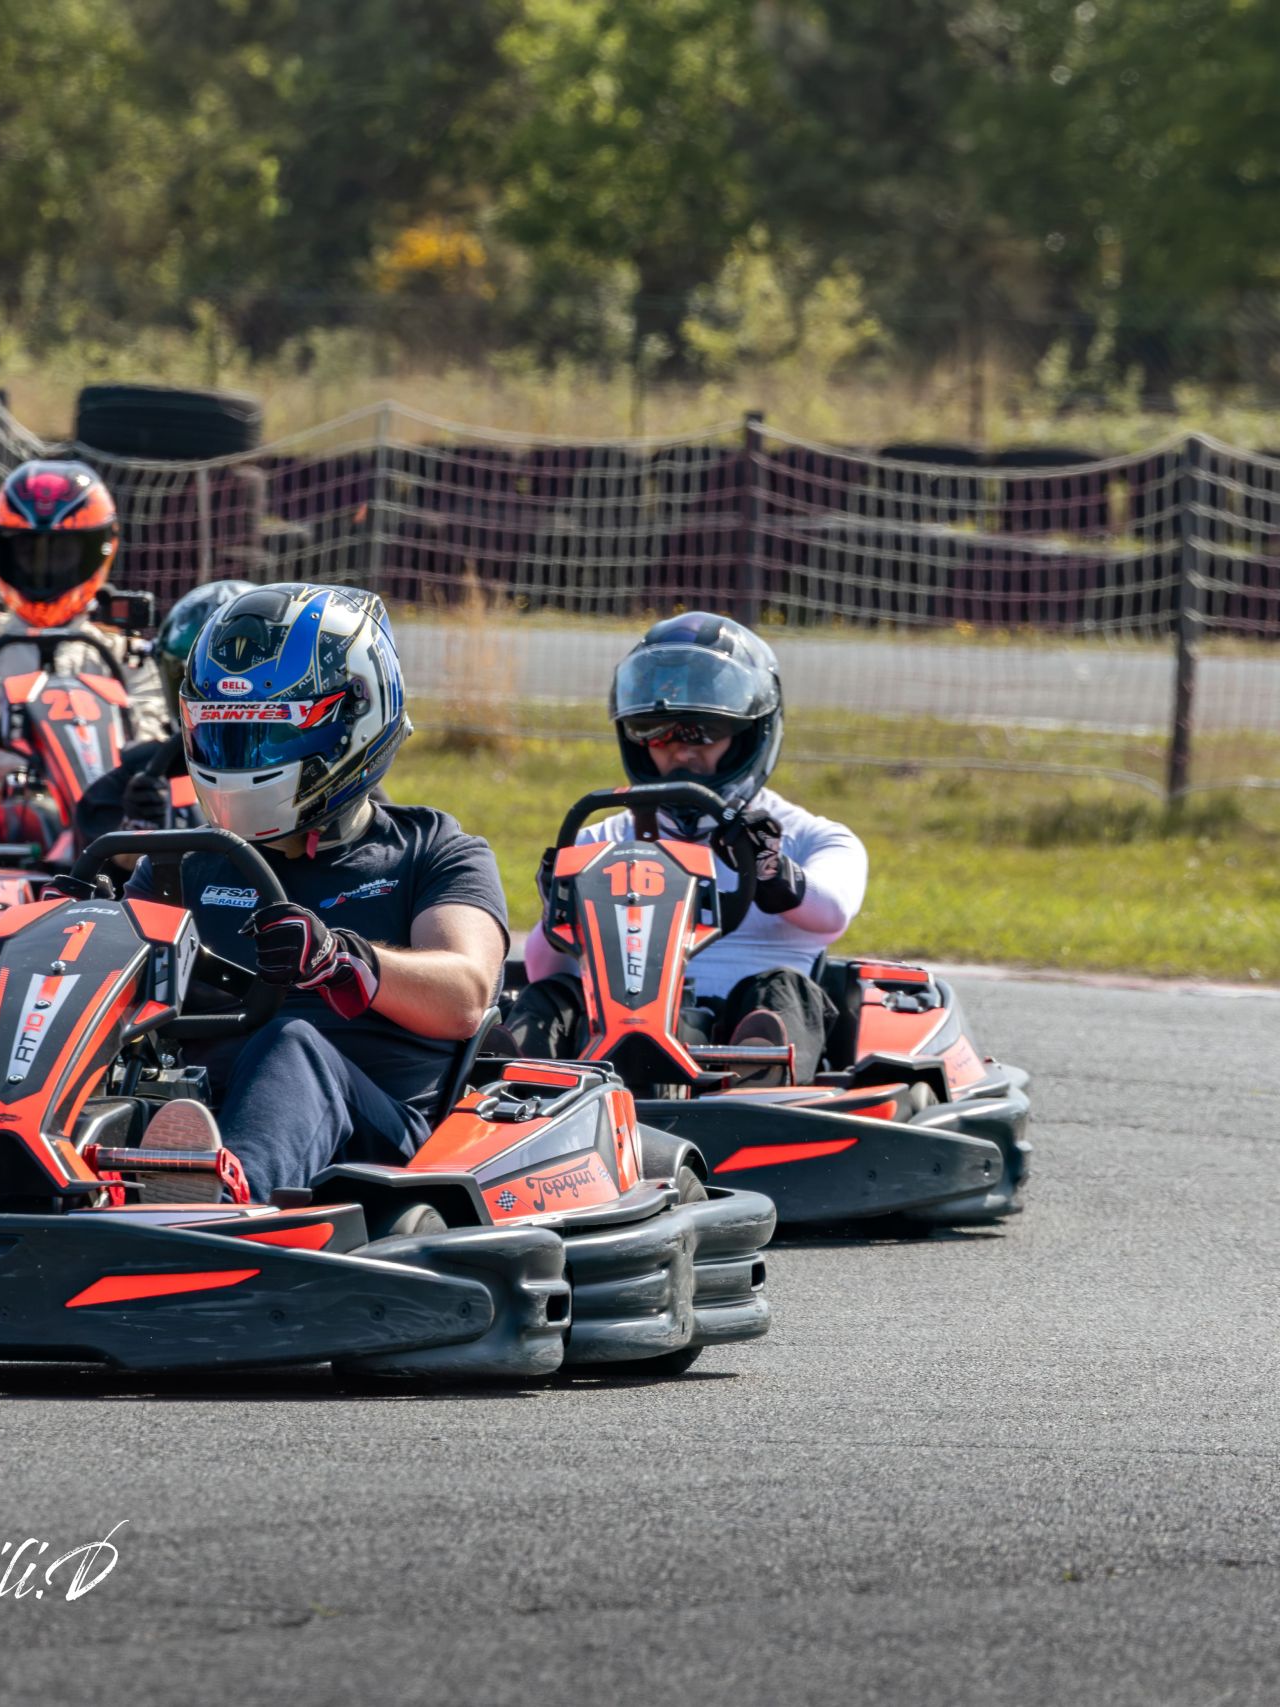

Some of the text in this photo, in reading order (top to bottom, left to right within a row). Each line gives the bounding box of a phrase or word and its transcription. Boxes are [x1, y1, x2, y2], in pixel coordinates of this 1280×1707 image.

[222, 681, 248, 690] BELL
[201, 703, 261, 711] KARTING
[200, 710, 289, 720] SAINTES
[602, 860, 666, 897] 16
[205, 886, 255, 898] FFSA
[217, 898, 255, 907] RALLYE
[66, 906, 120, 916] SODI
[62, 921, 97, 962] 1
[626, 934, 643, 978] RT10
[14, 1013, 45, 1063] RT10
[525, 1157, 596, 1212] Topgun
